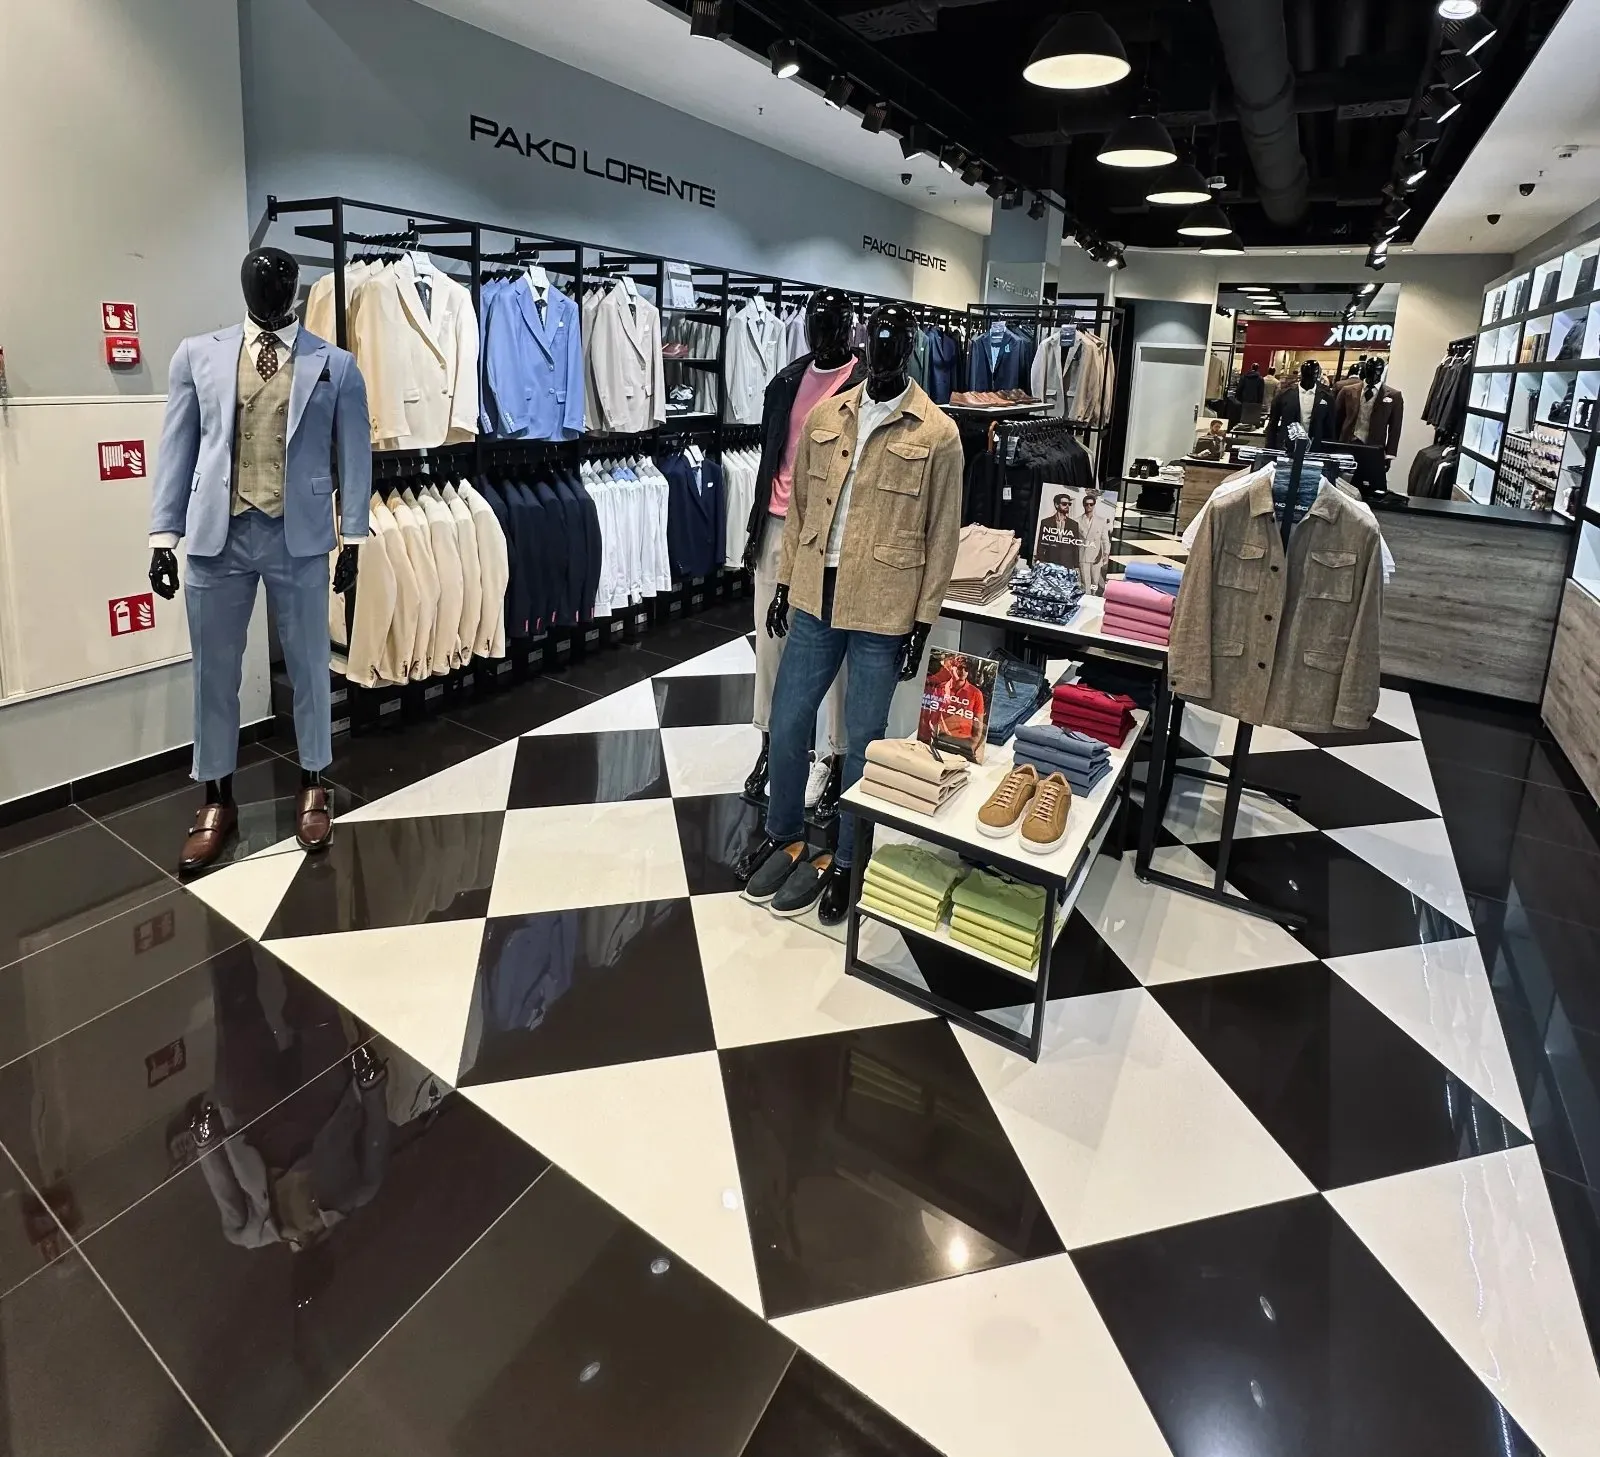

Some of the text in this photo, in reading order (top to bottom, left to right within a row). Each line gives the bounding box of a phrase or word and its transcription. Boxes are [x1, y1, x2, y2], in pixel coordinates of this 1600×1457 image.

[470, 114, 716, 208] PAKO LORENTE
[862, 235, 946, 271] PAKO LORENTE
[1043, 526, 1075, 537] NOWA
[1042, 534, 1097, 548] KOLEKCJA
[930, 700, 939, 710] 3
[944, 694, 969, 706] POLO
